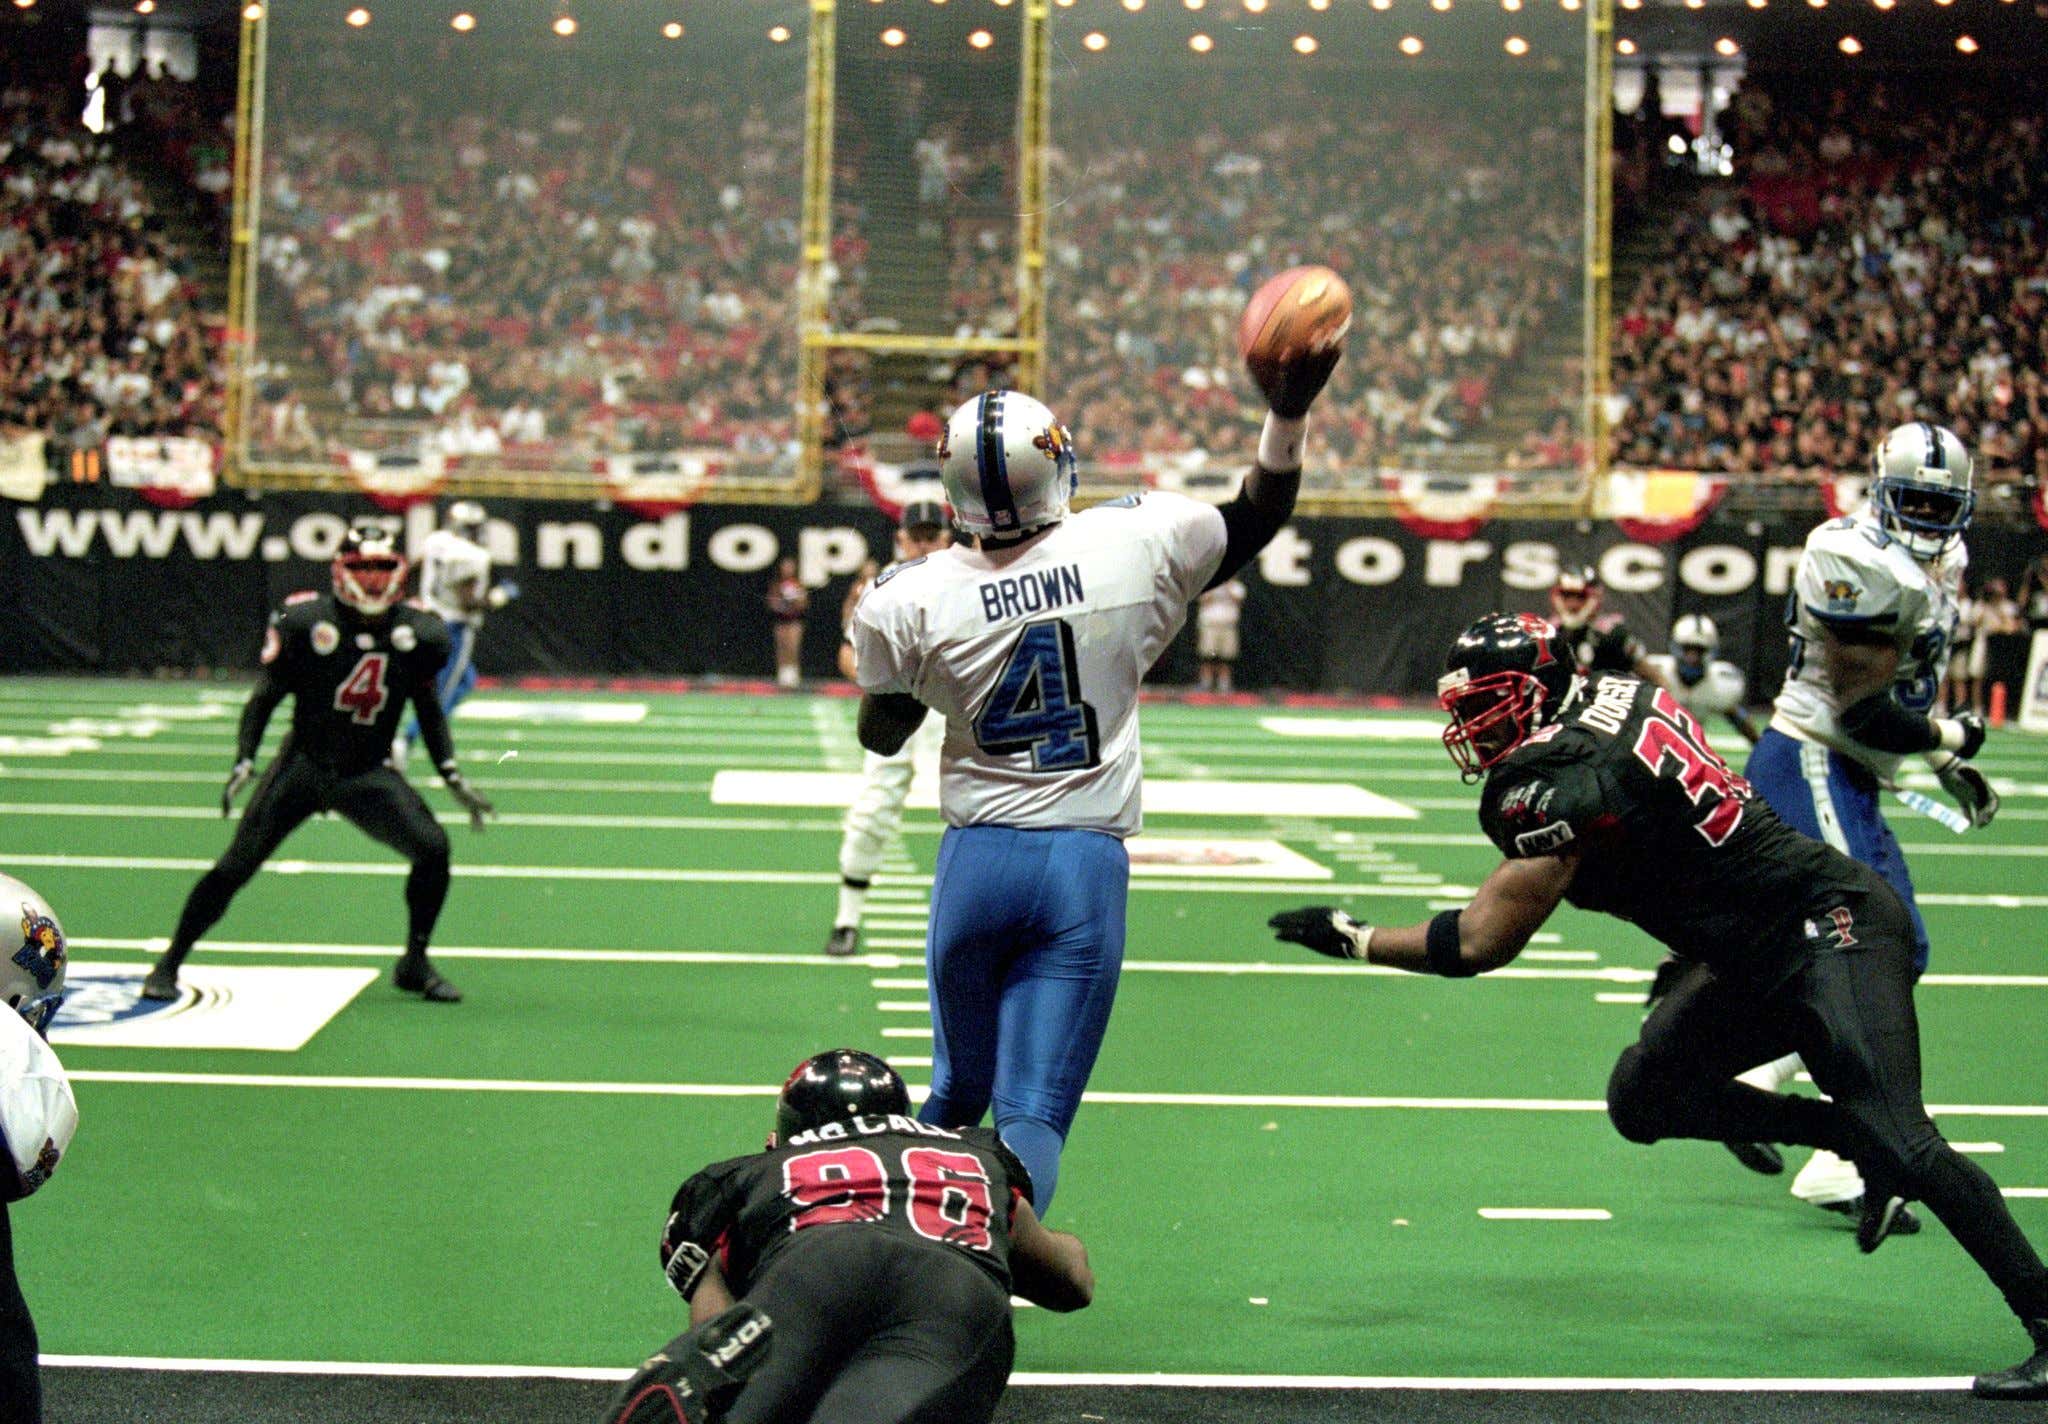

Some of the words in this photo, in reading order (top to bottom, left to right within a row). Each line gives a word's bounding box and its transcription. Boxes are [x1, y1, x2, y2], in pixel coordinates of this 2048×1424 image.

[979, 563, 1084, 623] BROWN
[333, 652, 389, 727] 4
[970, 617, 1101, 773] 4
[781, 1145, 994, 1251] 96
